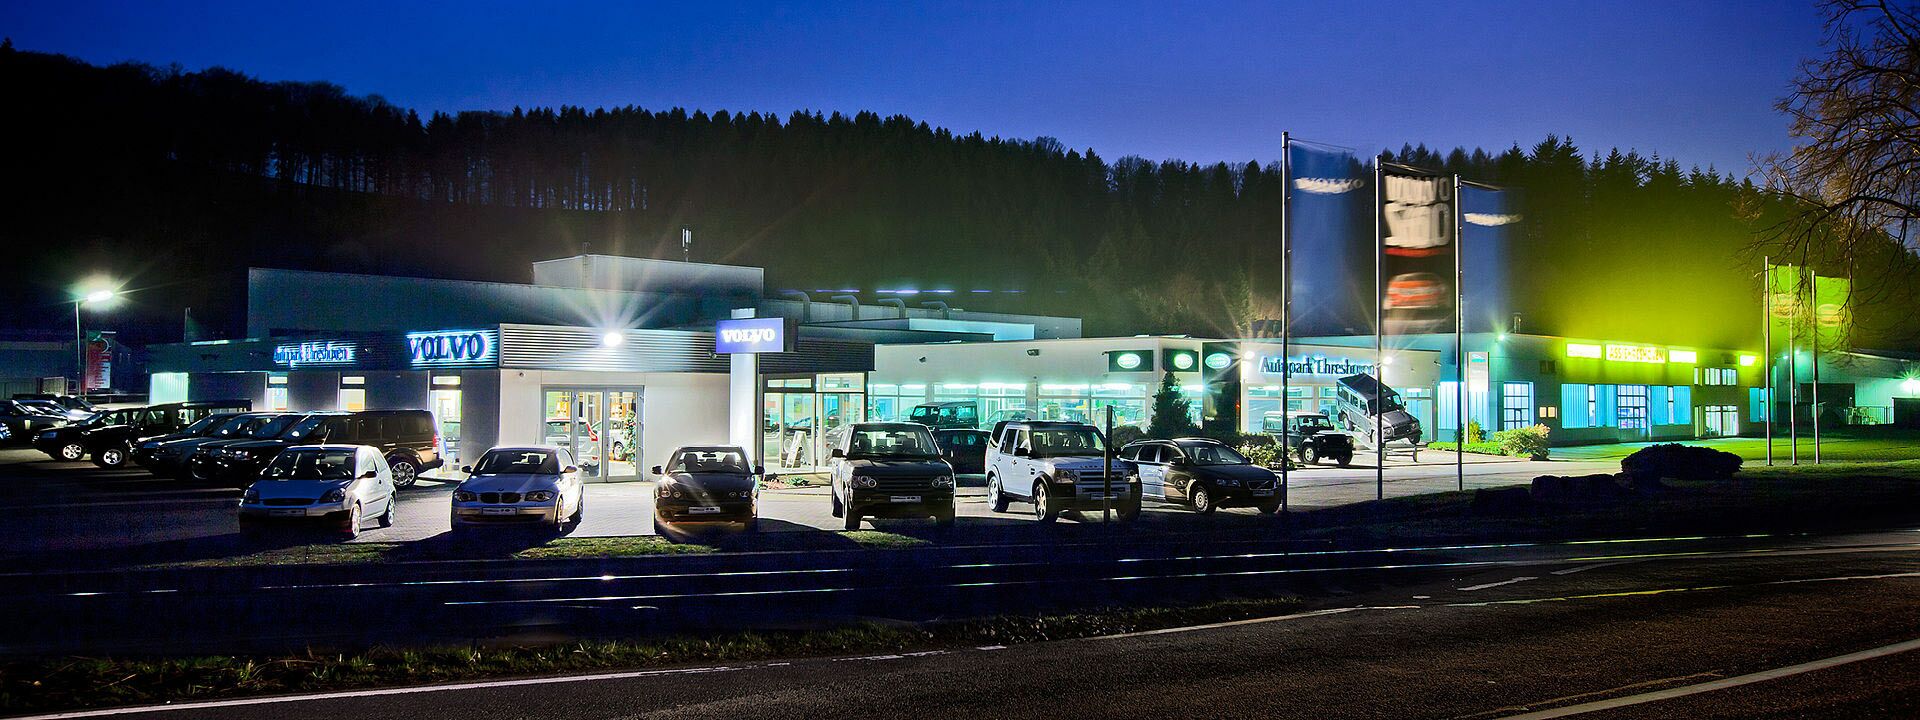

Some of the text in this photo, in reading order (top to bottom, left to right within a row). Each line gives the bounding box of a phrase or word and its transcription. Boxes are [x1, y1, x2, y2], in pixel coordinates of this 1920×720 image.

[721, 328, 776, 342] VOLVO
[408, 333, 486, 361] VOLVO
[1260, 356, 1313, 379] Autpark
